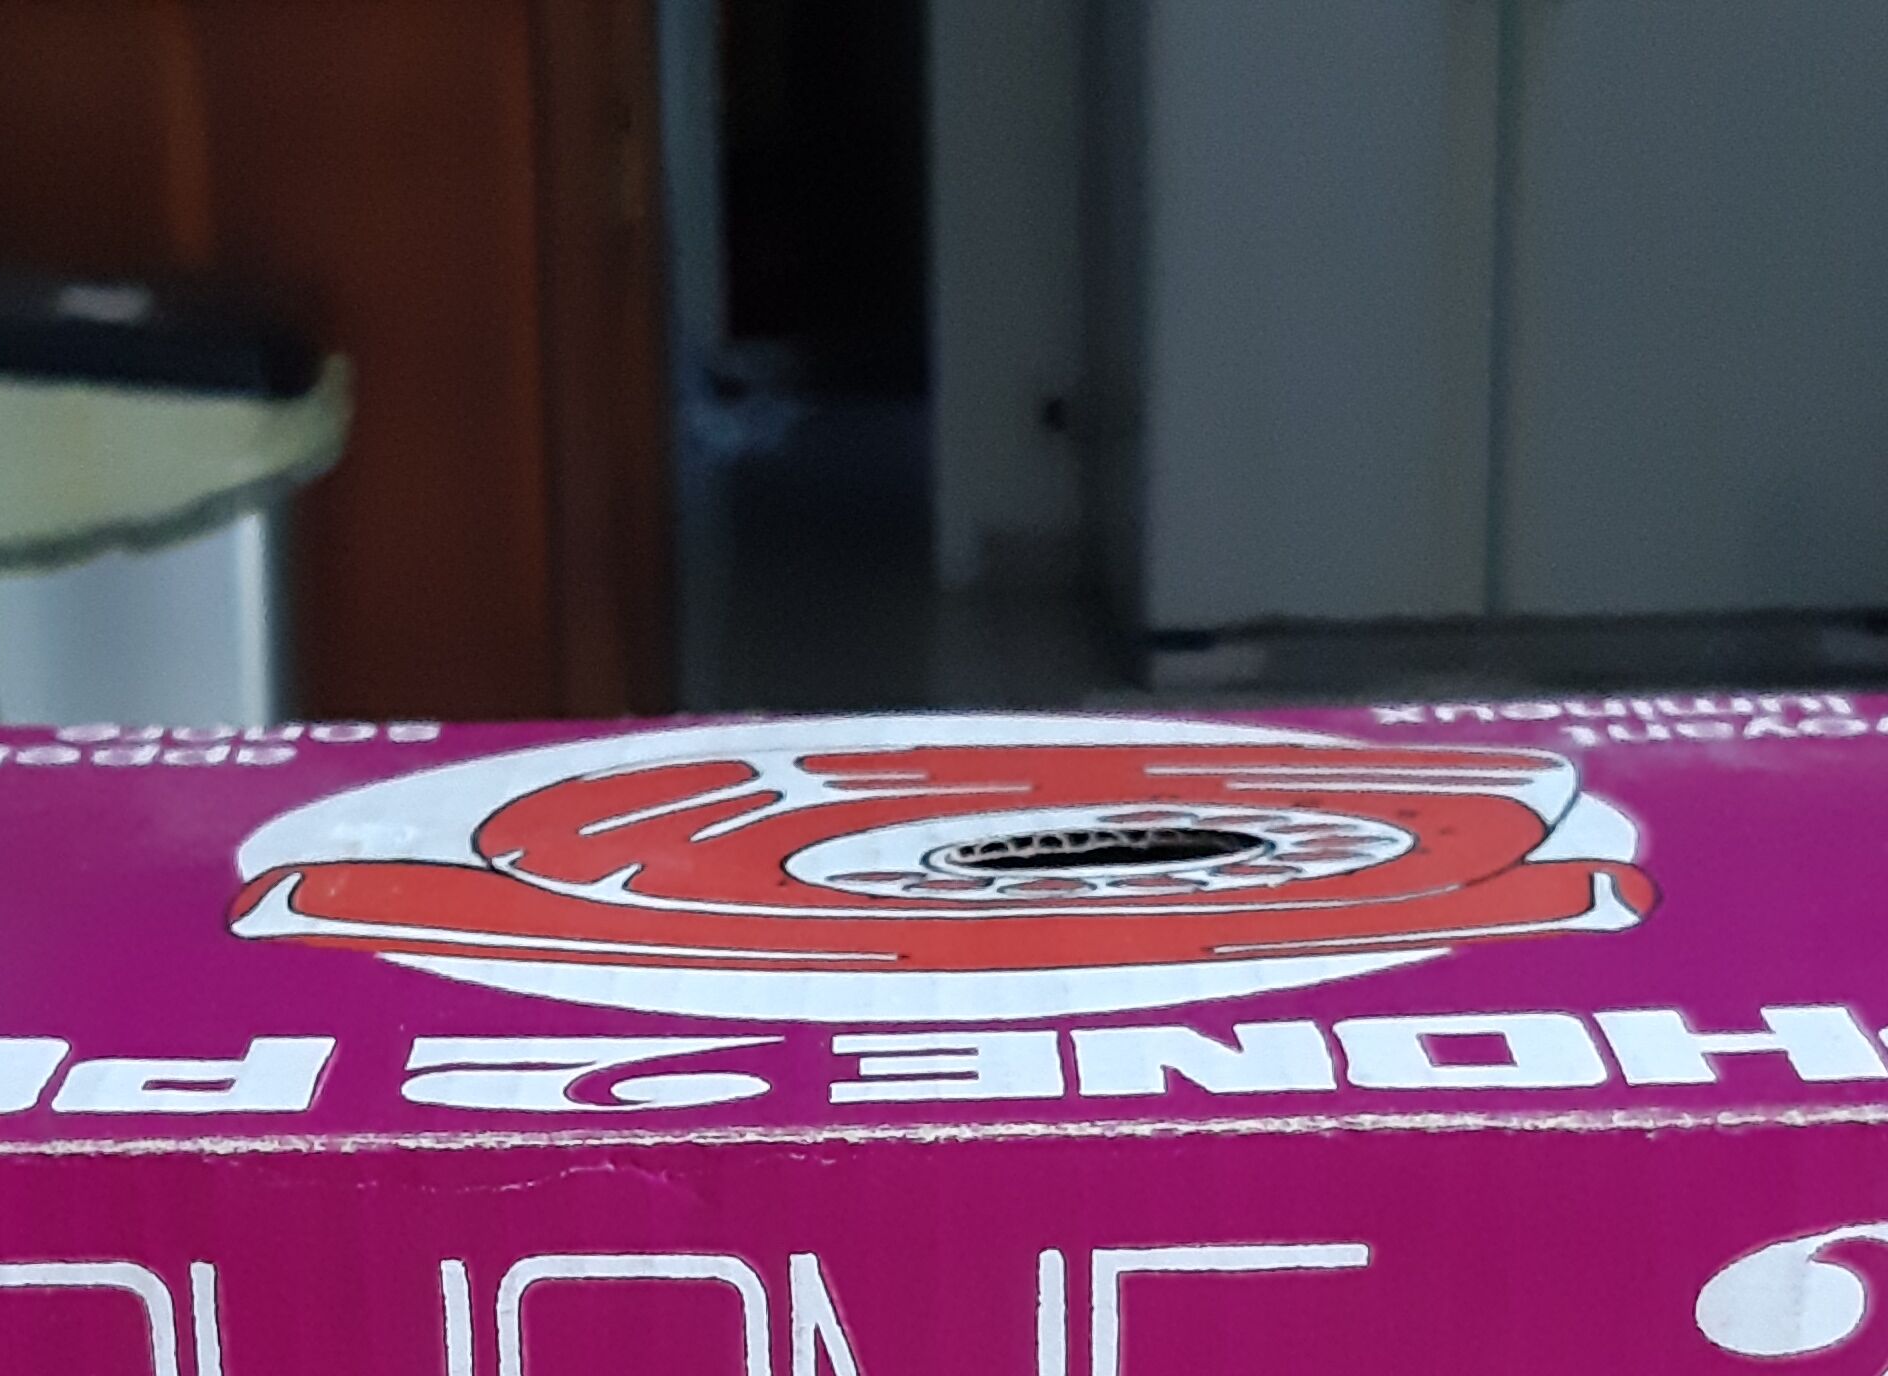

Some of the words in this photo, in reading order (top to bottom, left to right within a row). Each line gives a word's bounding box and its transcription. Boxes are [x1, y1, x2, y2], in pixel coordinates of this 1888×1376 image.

[1371, 695, 1854, 725] lumineux
[55, 721, 441, 743] sonore
[401, 1035, 786, 1111] 2
